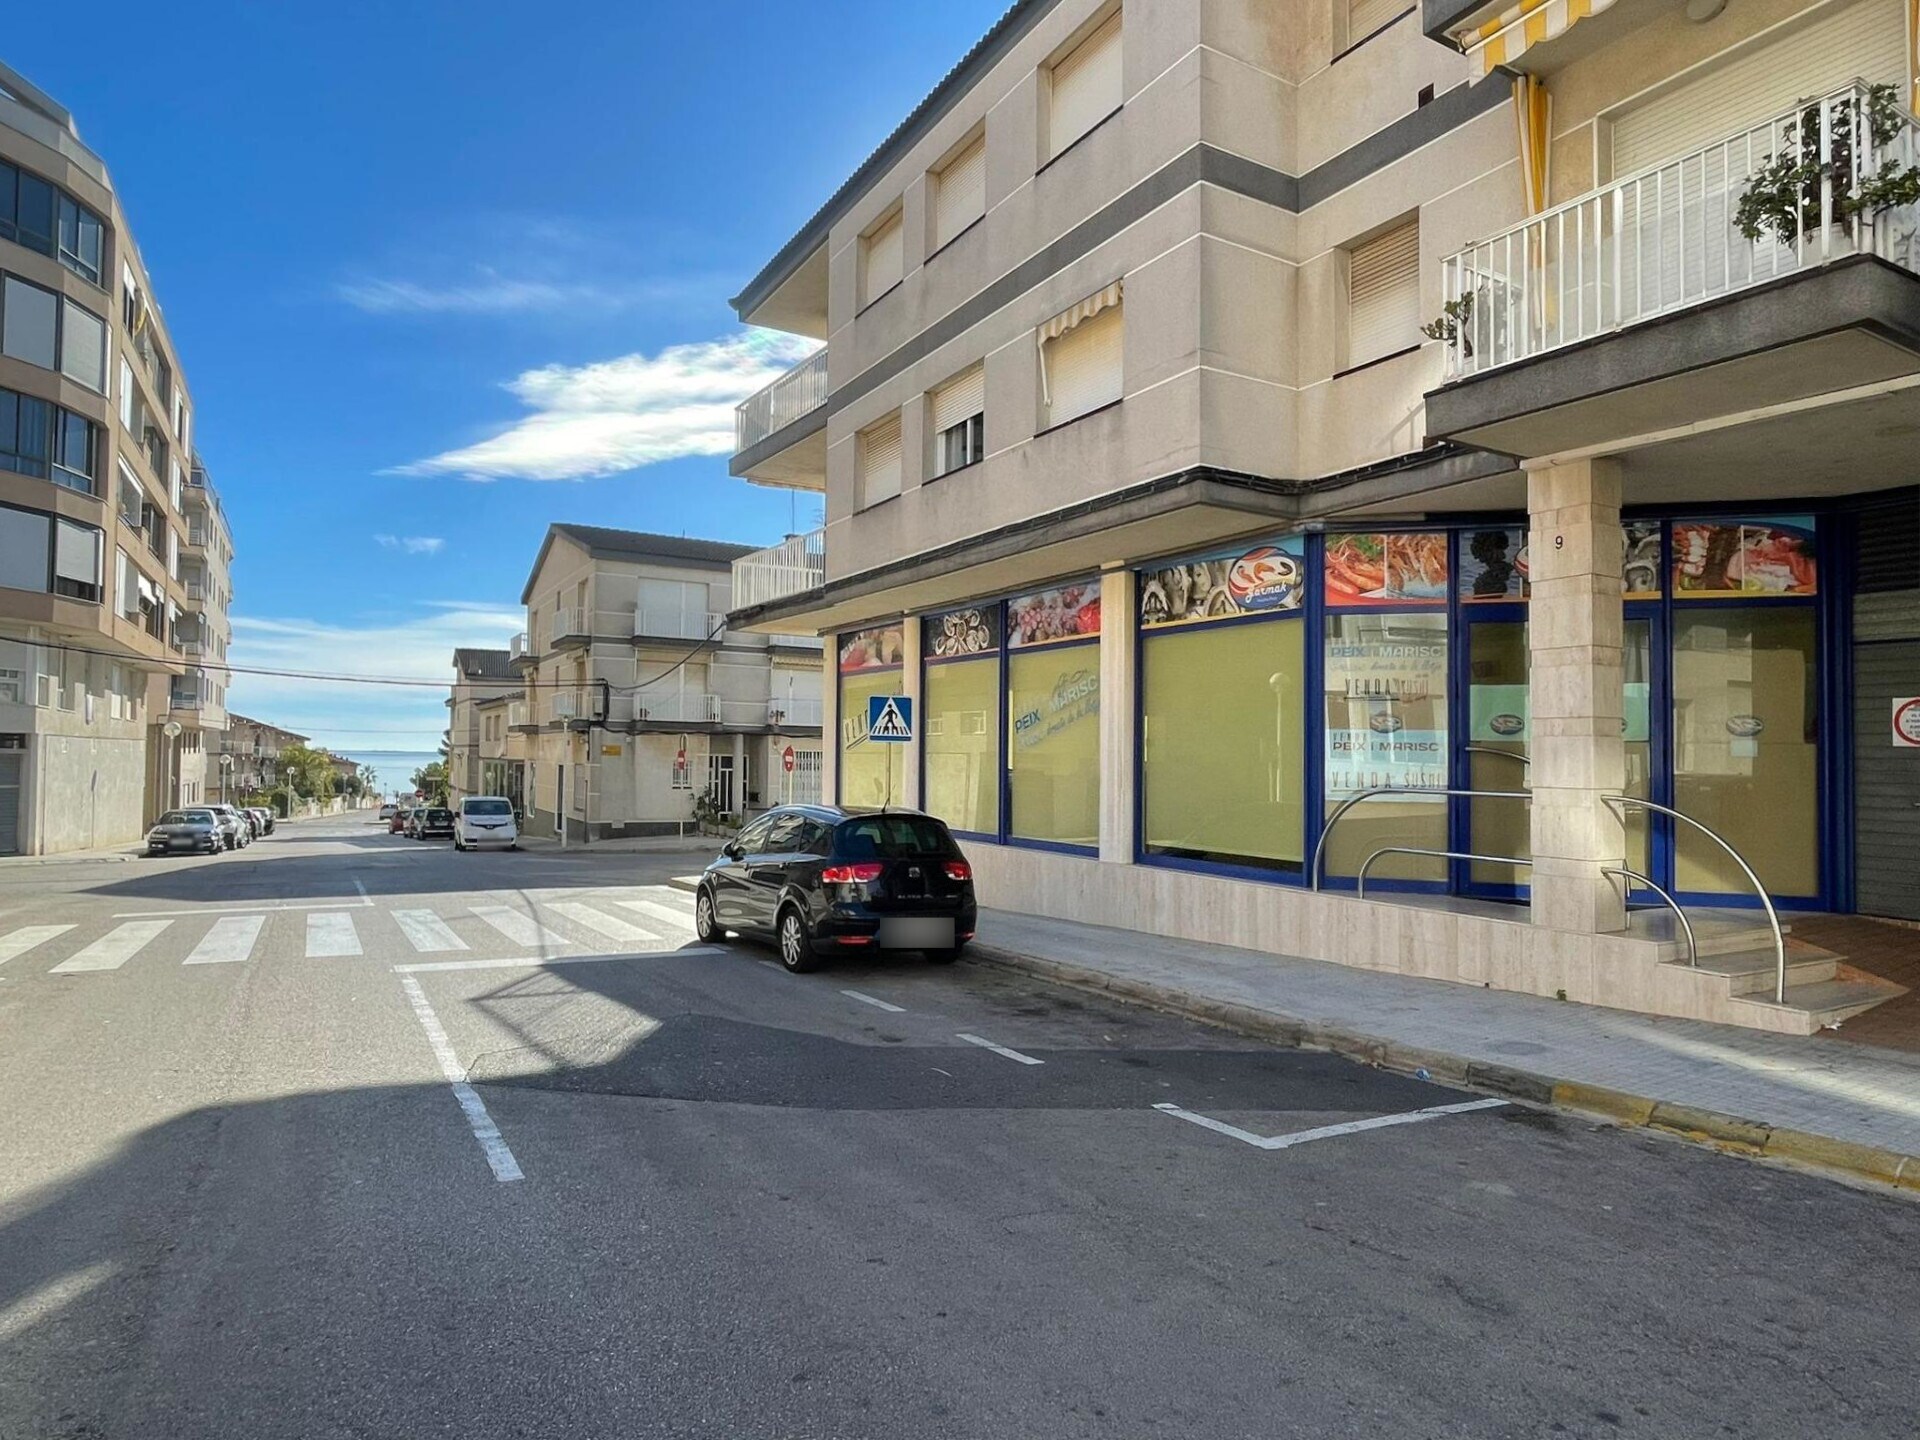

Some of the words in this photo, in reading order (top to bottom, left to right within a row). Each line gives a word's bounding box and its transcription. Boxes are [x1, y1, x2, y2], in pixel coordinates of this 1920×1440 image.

[1555, 535, 1563, 550] 9
[1331, 646, 1364, 657] PEIX
[1379, 646, 1441, 657] MARISC
[1344, 678, 1391, 696] VENDA
[1015, 708, 1041, 734] PEIX
[1049, 675, 1098, 715] MARISC
[1333, 742, 1366, 751] PEIX
[1379, 743, 1440, 752] MARISC
[1332, 771, 1392, 789] VENDA
